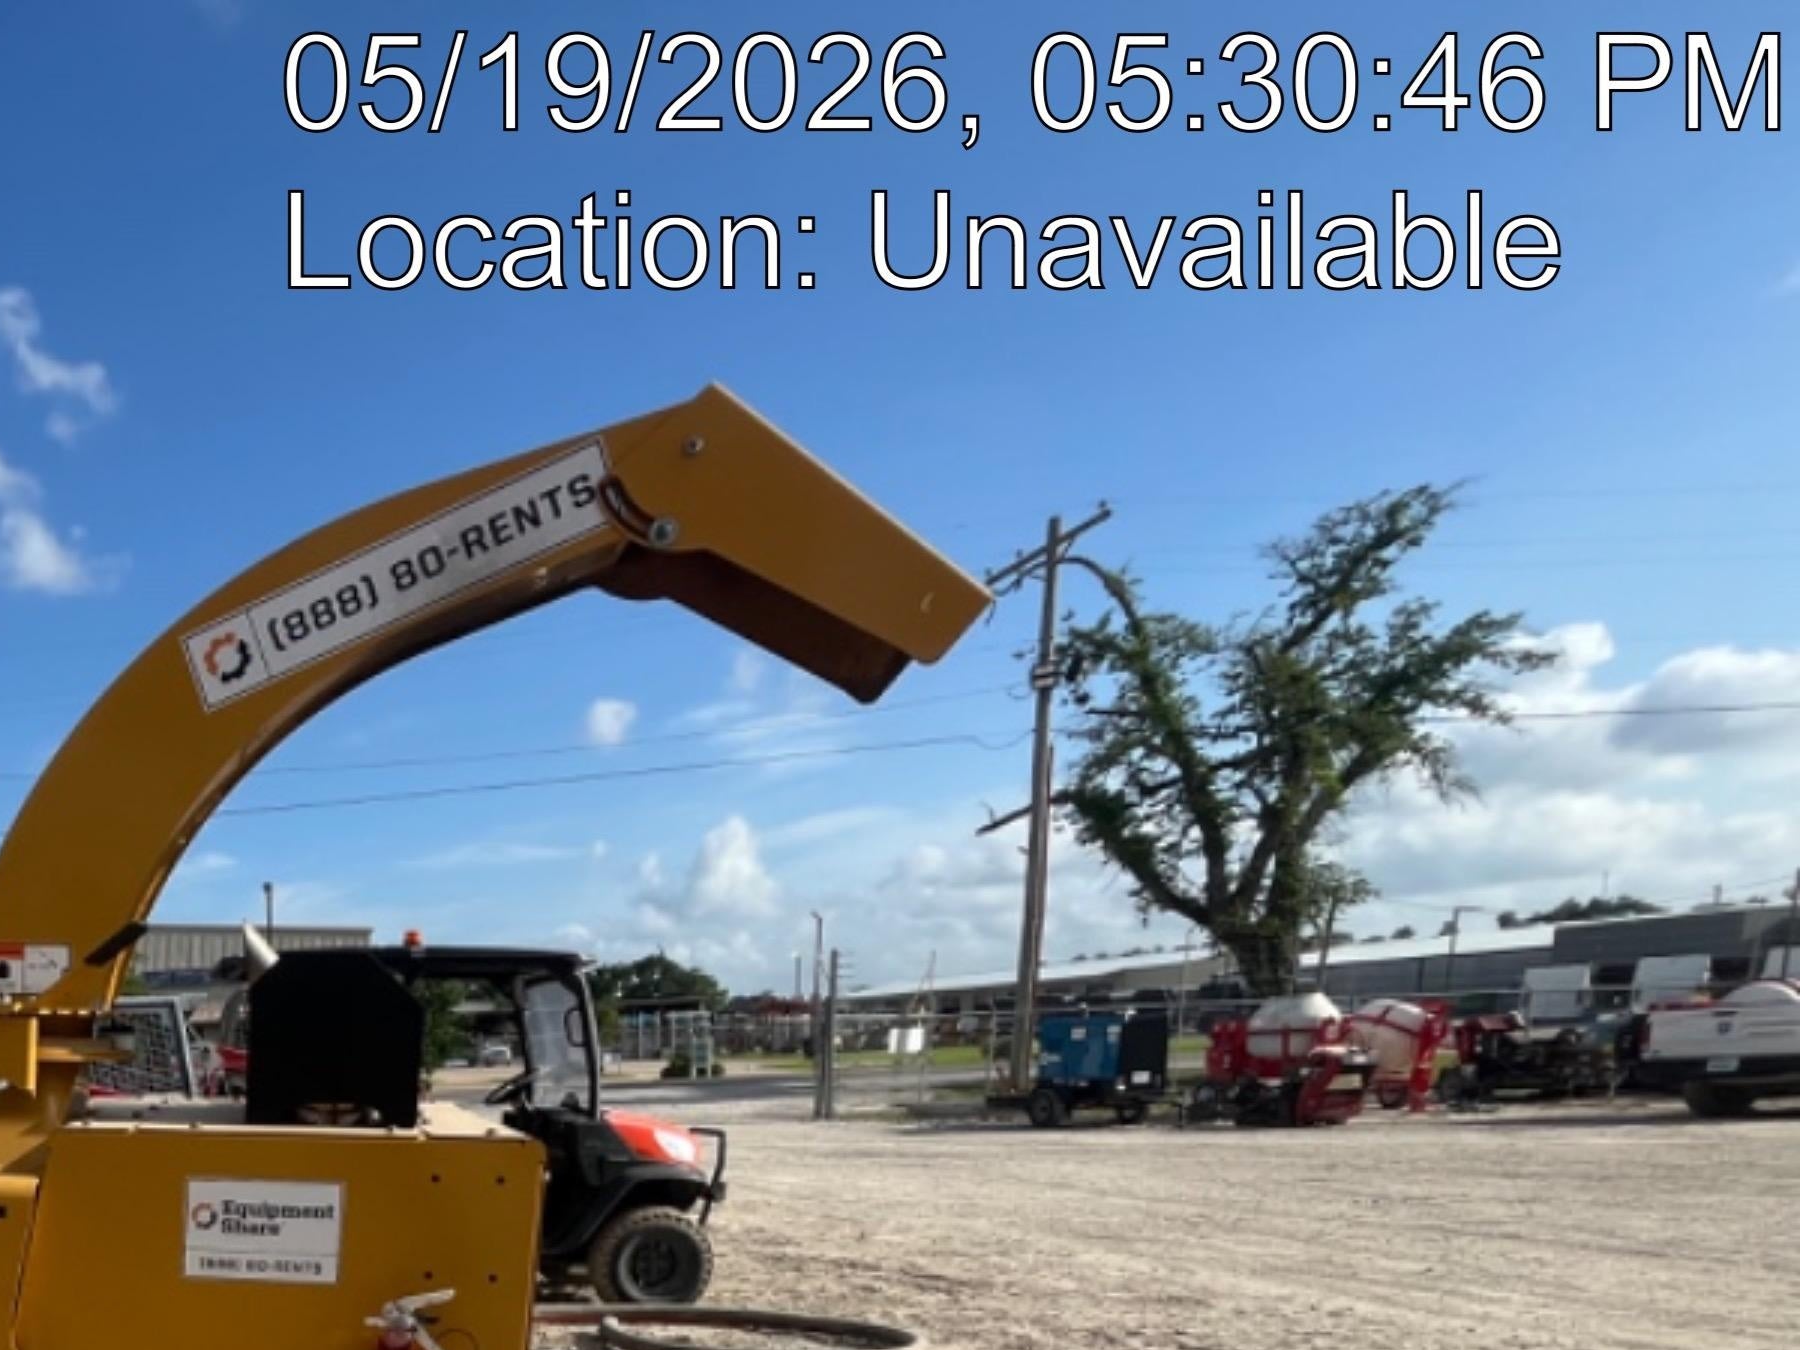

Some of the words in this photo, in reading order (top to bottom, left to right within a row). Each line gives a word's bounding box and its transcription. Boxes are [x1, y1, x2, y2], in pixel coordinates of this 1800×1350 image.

[267, 574, 378, 651] (888)
[389, 473, 598, 591] 80-RENTS
[221, 1199, 335, 1220] Equipment
[221, 1217, 281, 1236] Share
